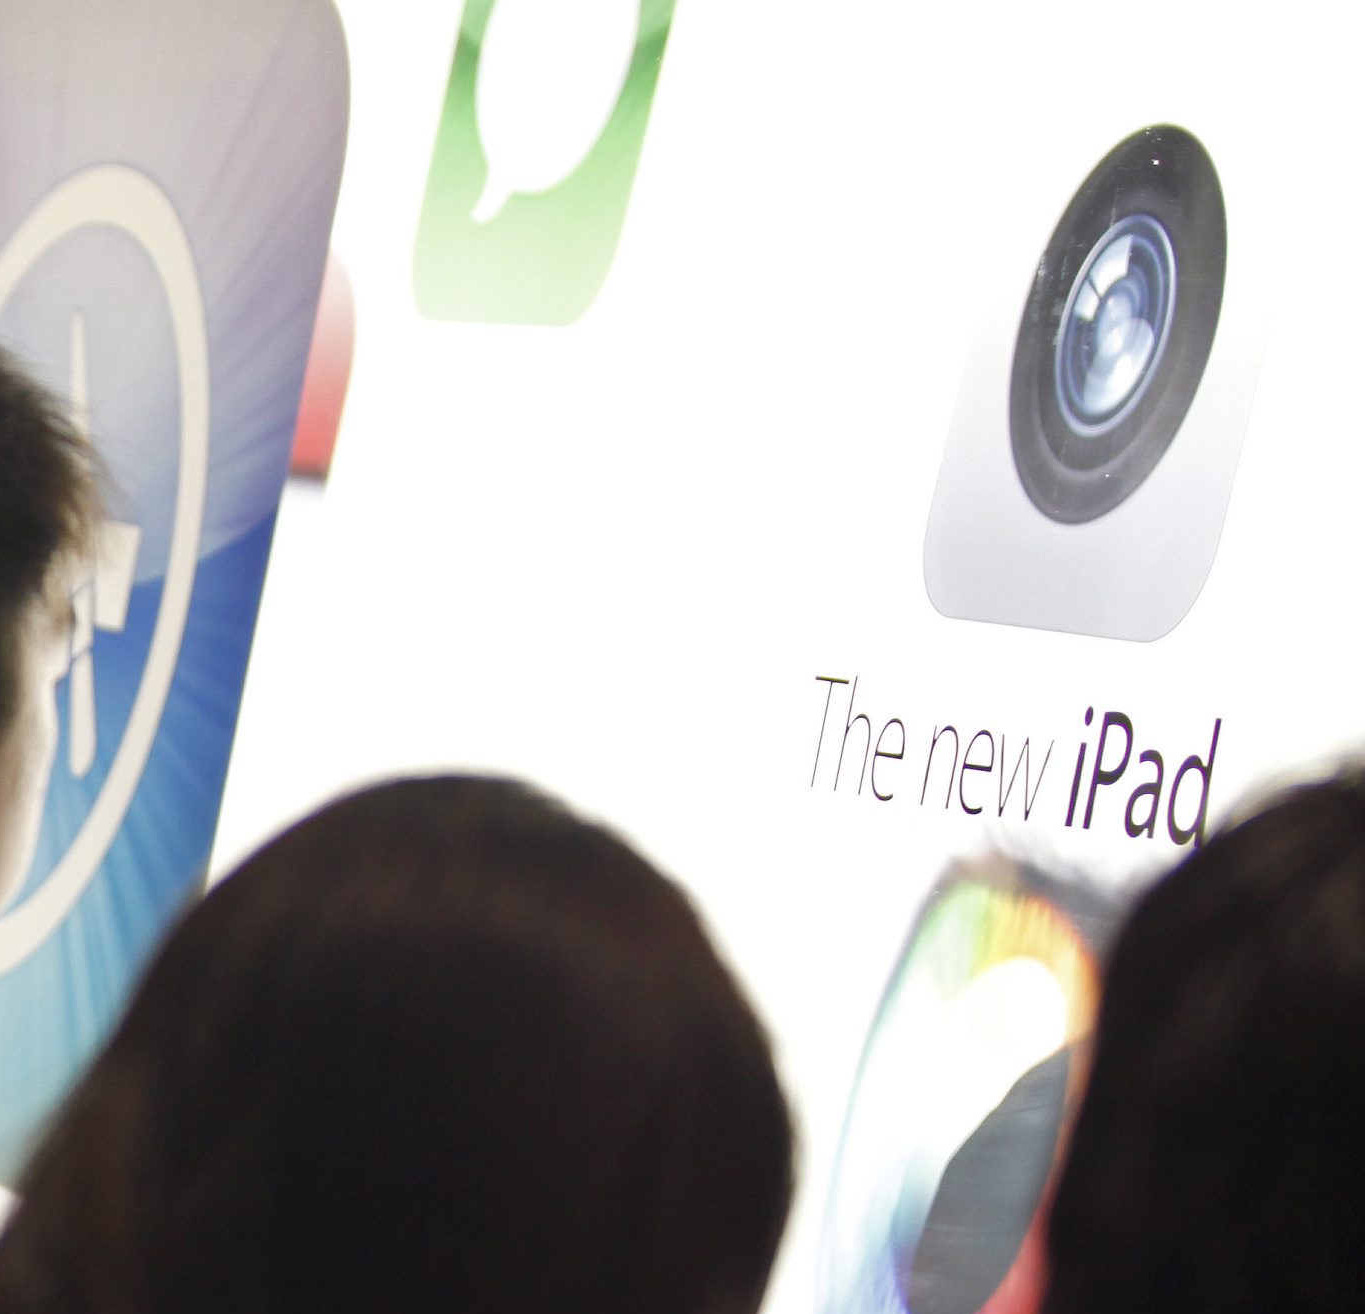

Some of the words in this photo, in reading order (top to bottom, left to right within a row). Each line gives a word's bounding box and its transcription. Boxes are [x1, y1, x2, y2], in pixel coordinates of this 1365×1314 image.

[810, 675, 906, 801] The
[920, 725, 1055, 821] new
[1065, 706, 1222, 847] iPad
